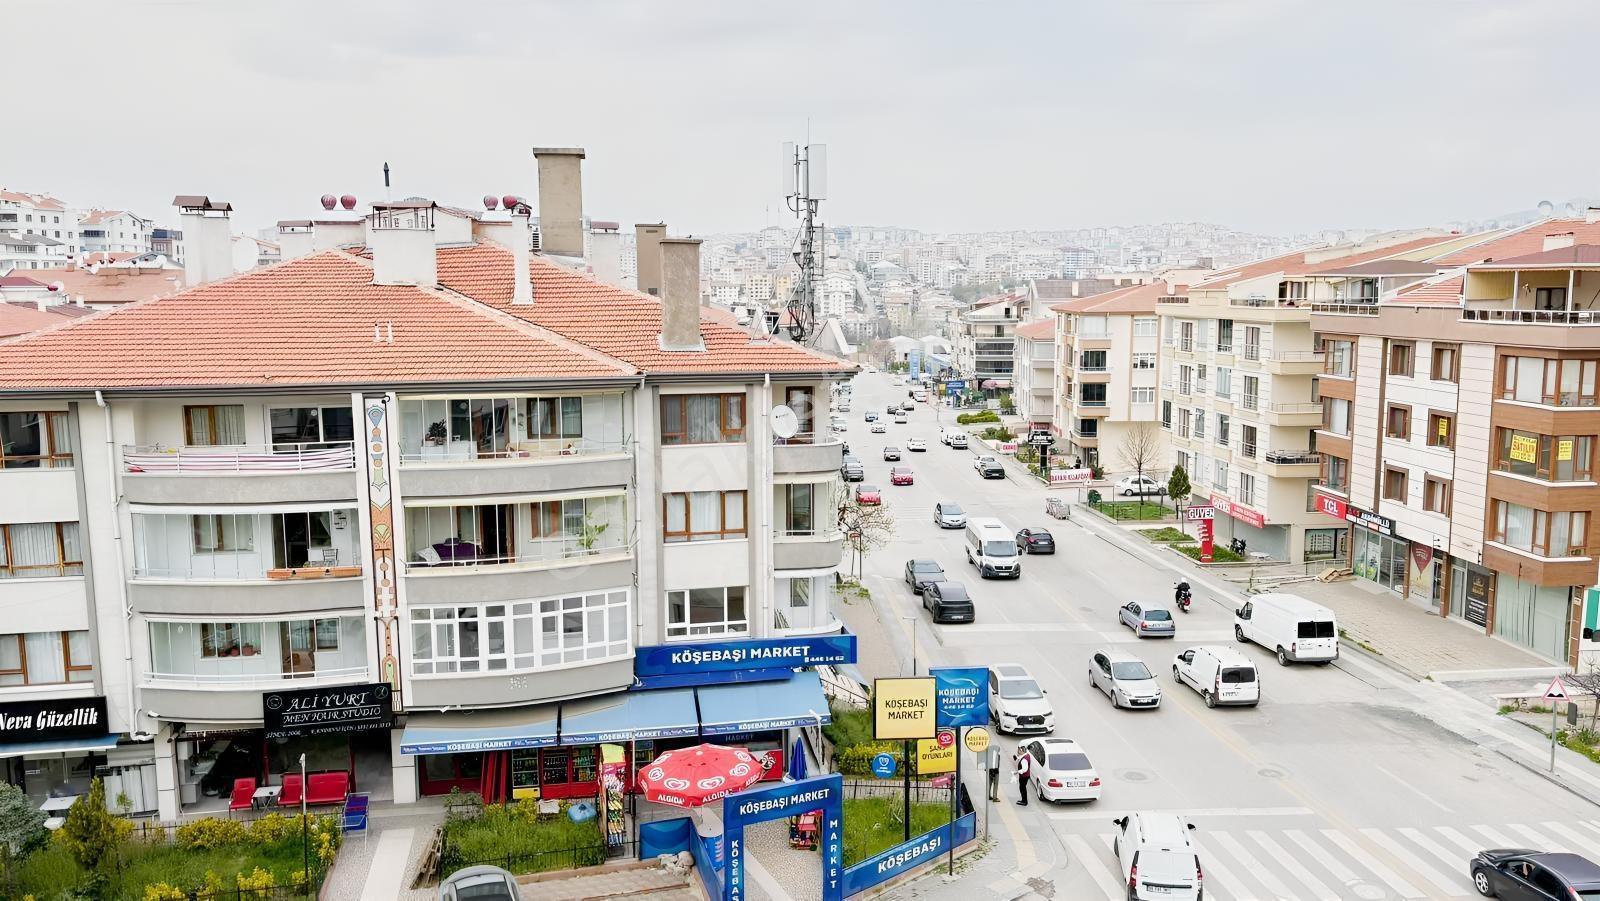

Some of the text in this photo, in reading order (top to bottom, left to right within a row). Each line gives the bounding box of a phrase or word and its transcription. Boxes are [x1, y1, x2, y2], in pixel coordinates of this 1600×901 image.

[1323, 498, 1338, 513] TCL
[671, 646, 810, 664] KÖŞEBAŞI MARKET
[286, 692, 369, 711] ALİ YURT
[0, 707, 98, 731] Neva Güzellik
[341, 706, 381, 719] STUDIO
[888, 710, 924, 720] MARKET
[770, 719, 796, 729] MARKET
[634, 729, 662, 738] MARKET
[484, 740, 513, 750] MARKET
[739, 788, 830, 815] KÖŞEBAŞI MARKET
[829, 819, 838, 889] MARKET
[878, 836, 941, 873] KÖŞEBAŞI
